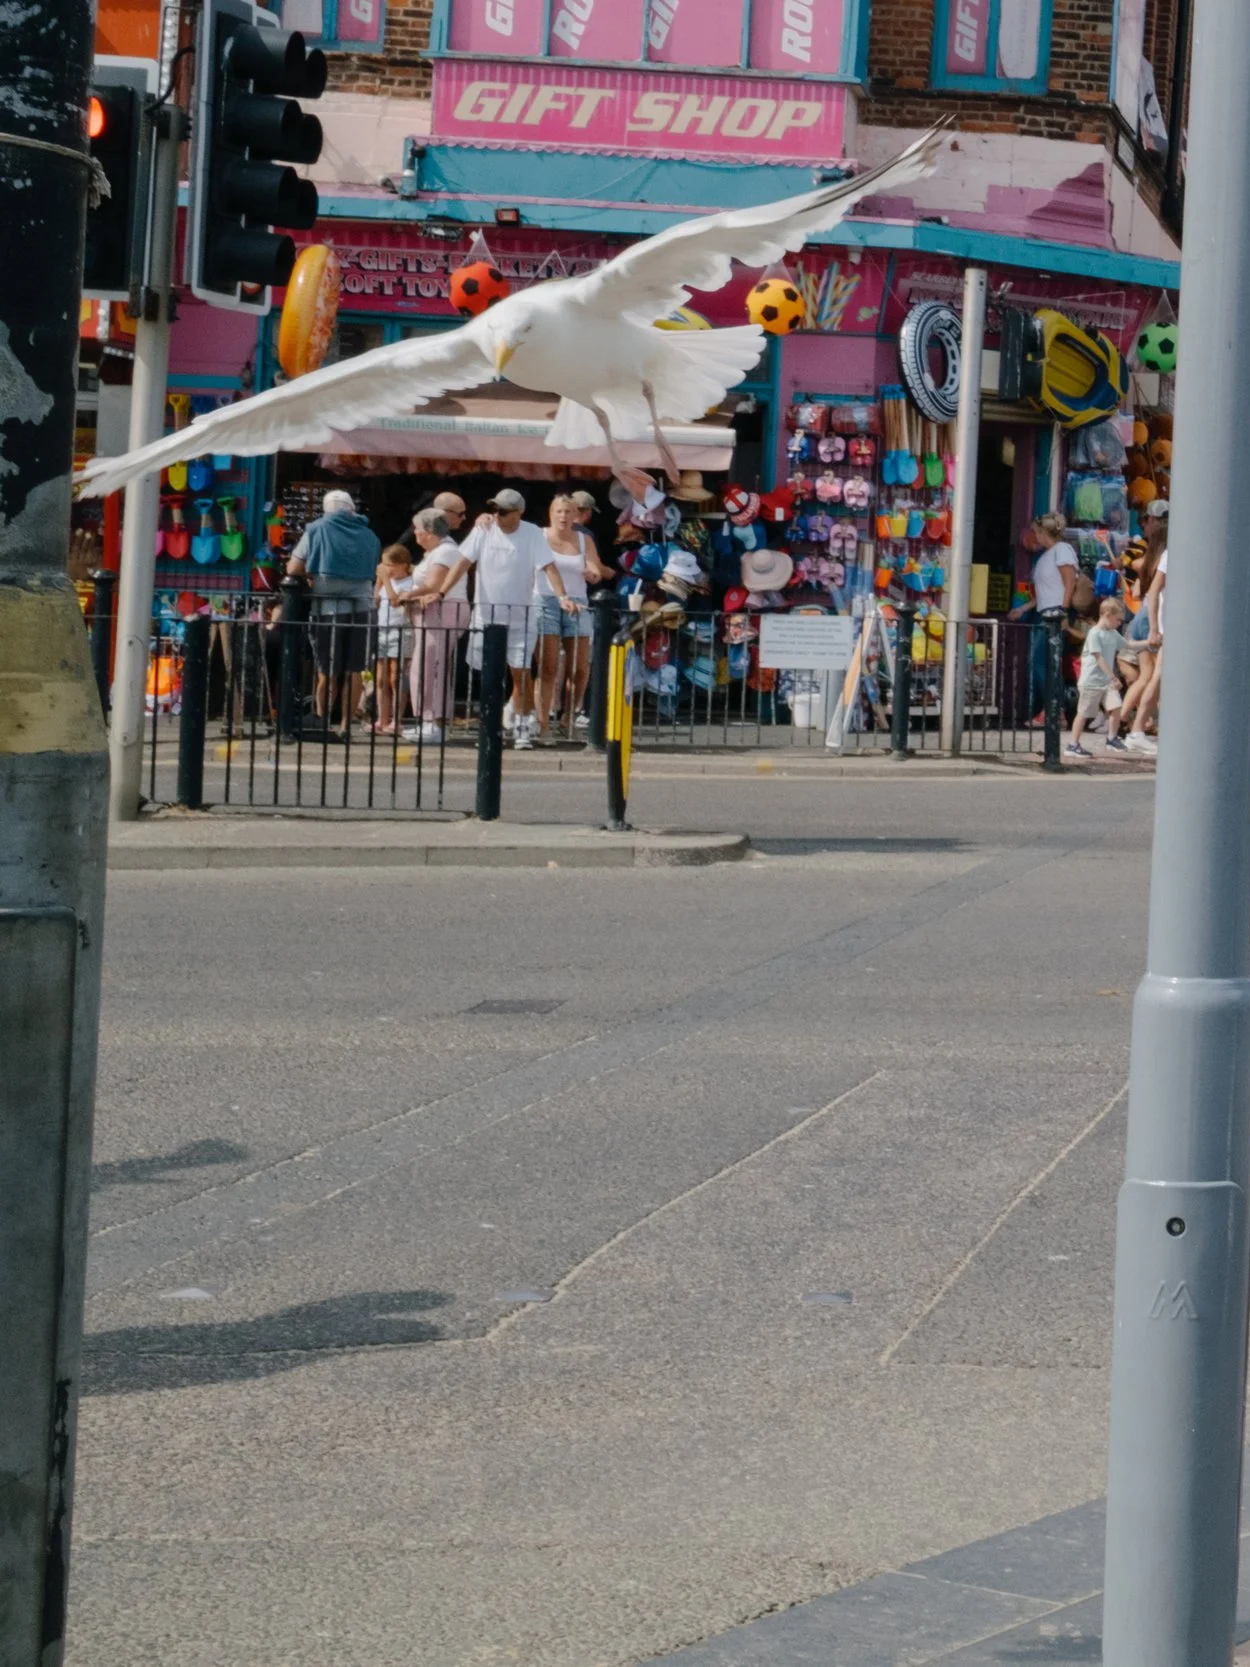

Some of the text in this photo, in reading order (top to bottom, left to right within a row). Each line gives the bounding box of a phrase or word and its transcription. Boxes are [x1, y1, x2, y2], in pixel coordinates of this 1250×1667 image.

[781, 0, 814, 64] RO
[954, 0, 979, 62] GIF
[453, 80, 823, 140] GIFT SHOP
[340, 274, 451, 298] OFT TOY
[380, 416, 457, 432] Traditional
[465, 420, 509, 434] Italian
[518, 423, 538, 435] Ice
